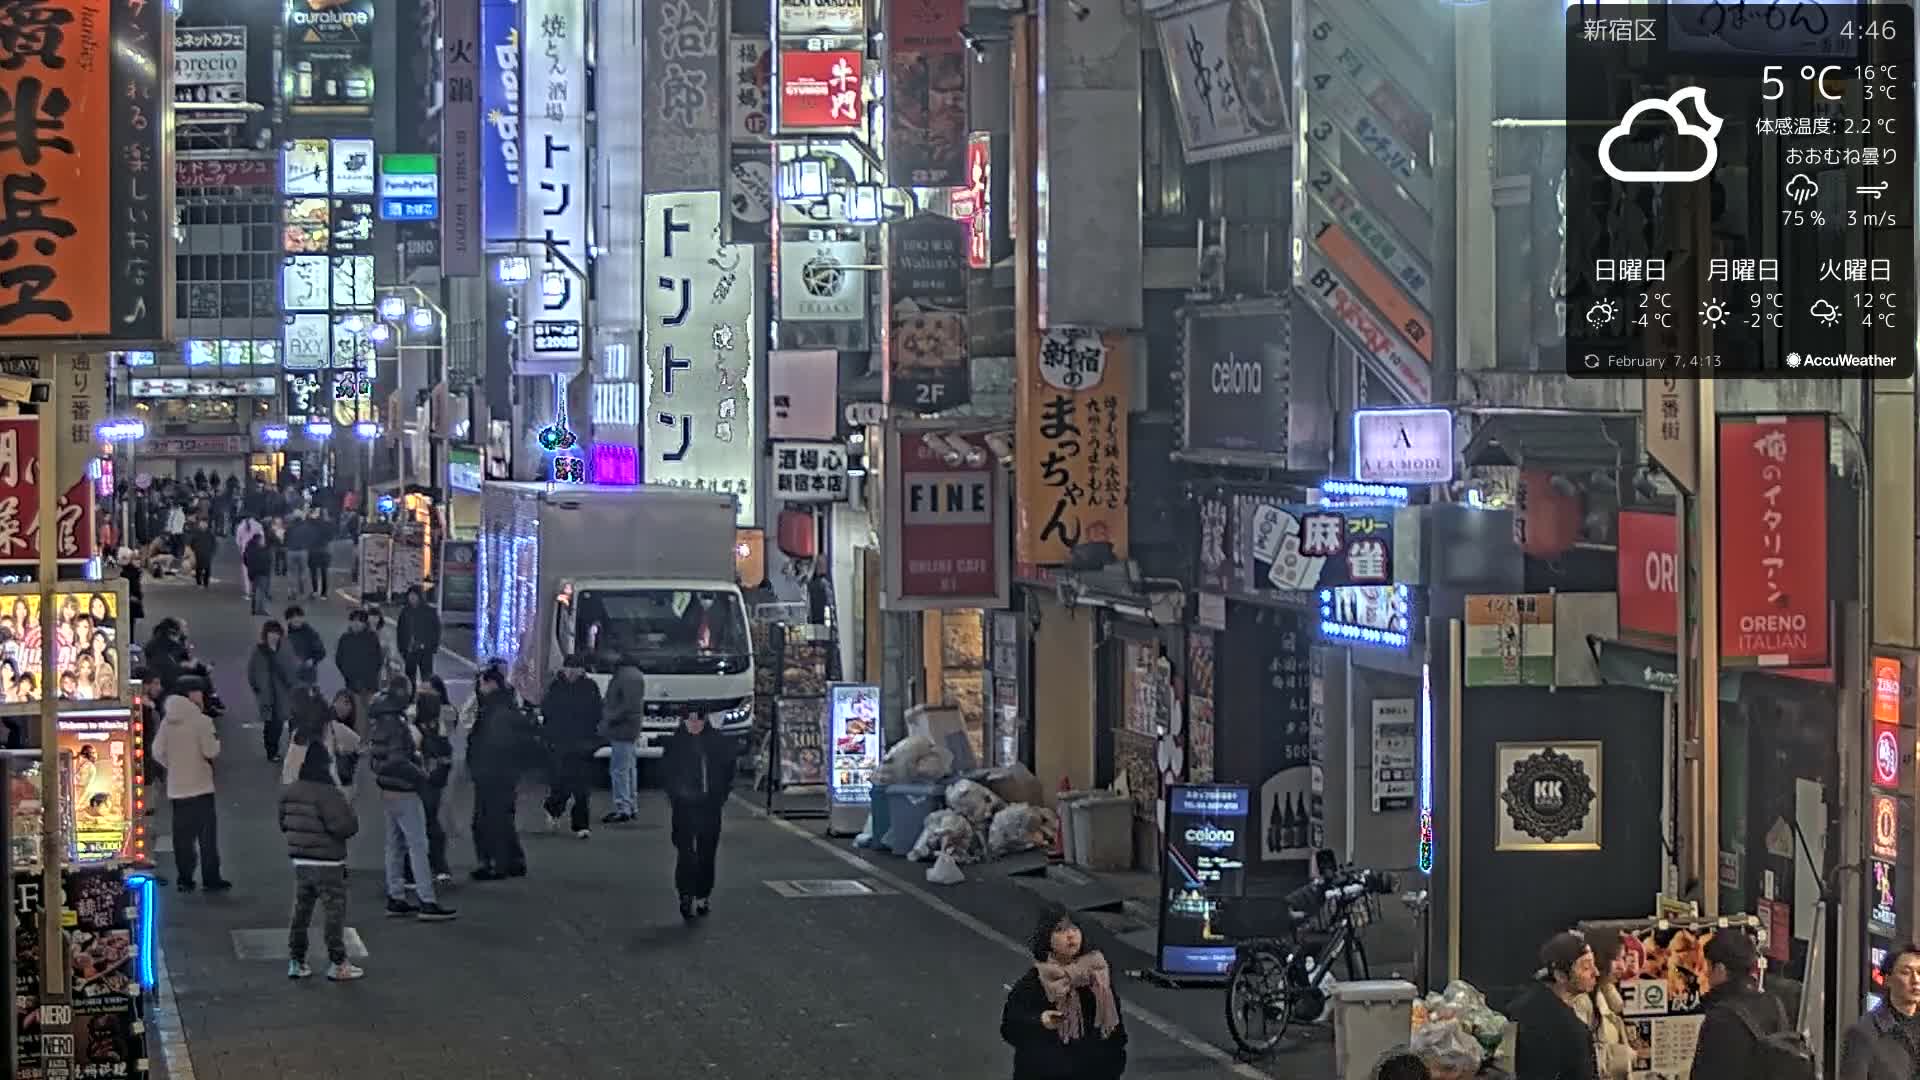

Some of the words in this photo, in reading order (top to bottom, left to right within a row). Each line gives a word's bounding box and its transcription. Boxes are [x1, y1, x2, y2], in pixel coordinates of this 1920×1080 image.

[828, 57, 858, 120] 牛門
[659, 207, 693, 463] トントン
[1212, 352, 1262, 394] celona
[915, 384, 945, 403] 2F
[1392, 422, 1412, 449] A
[778, 474, 842, 491] 新宿本店
[1039, 395, 1084, 547] まっちゃん
[910, 483, 985, 513] FINE
[1347, 517, 1390, 534] フリー
[1752, 428, 1789, 603] 俺のイタリアン
[1645, 551, 1678, 592] OR
[1739, 615, 1807, 633] ORENO
[1738, 634, 1808, 650] ITALIAN
[1534, 780, 1562, 798] KK
[40, 1005, 71, 1024] NERO
